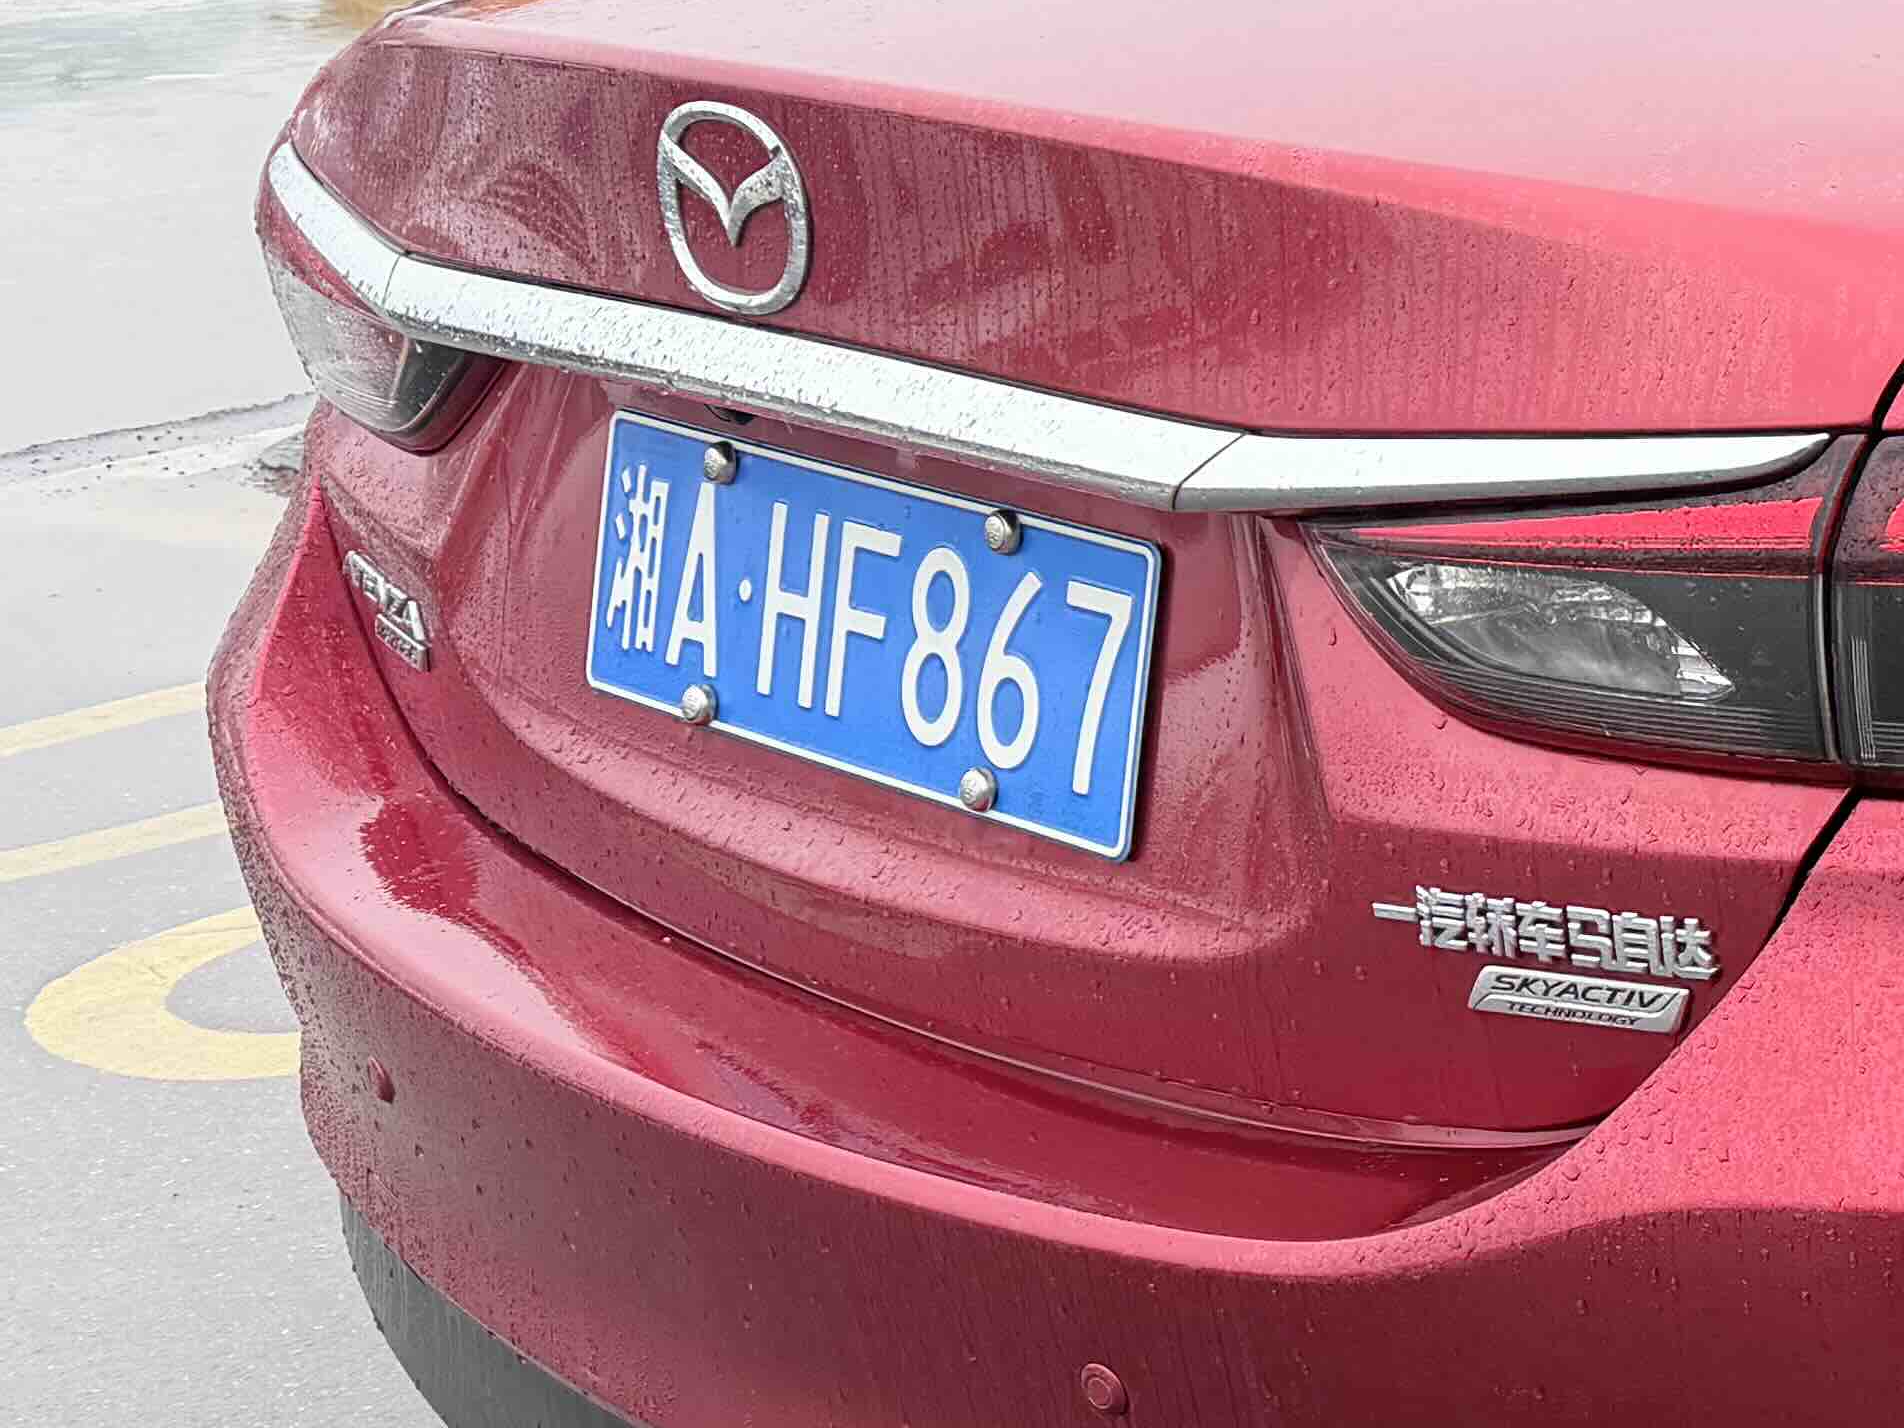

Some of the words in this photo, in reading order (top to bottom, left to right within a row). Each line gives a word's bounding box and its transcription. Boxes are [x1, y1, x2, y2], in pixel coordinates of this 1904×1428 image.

[606, 464, 1133, 796] 湘A·HF867
[1372, 885, 1721, 980] 一汽轿车马自达
[1491, 974, 1665, 1009] SKYACTIV
[1507, 1002, 1641, 1027] TECHNOLOGY
